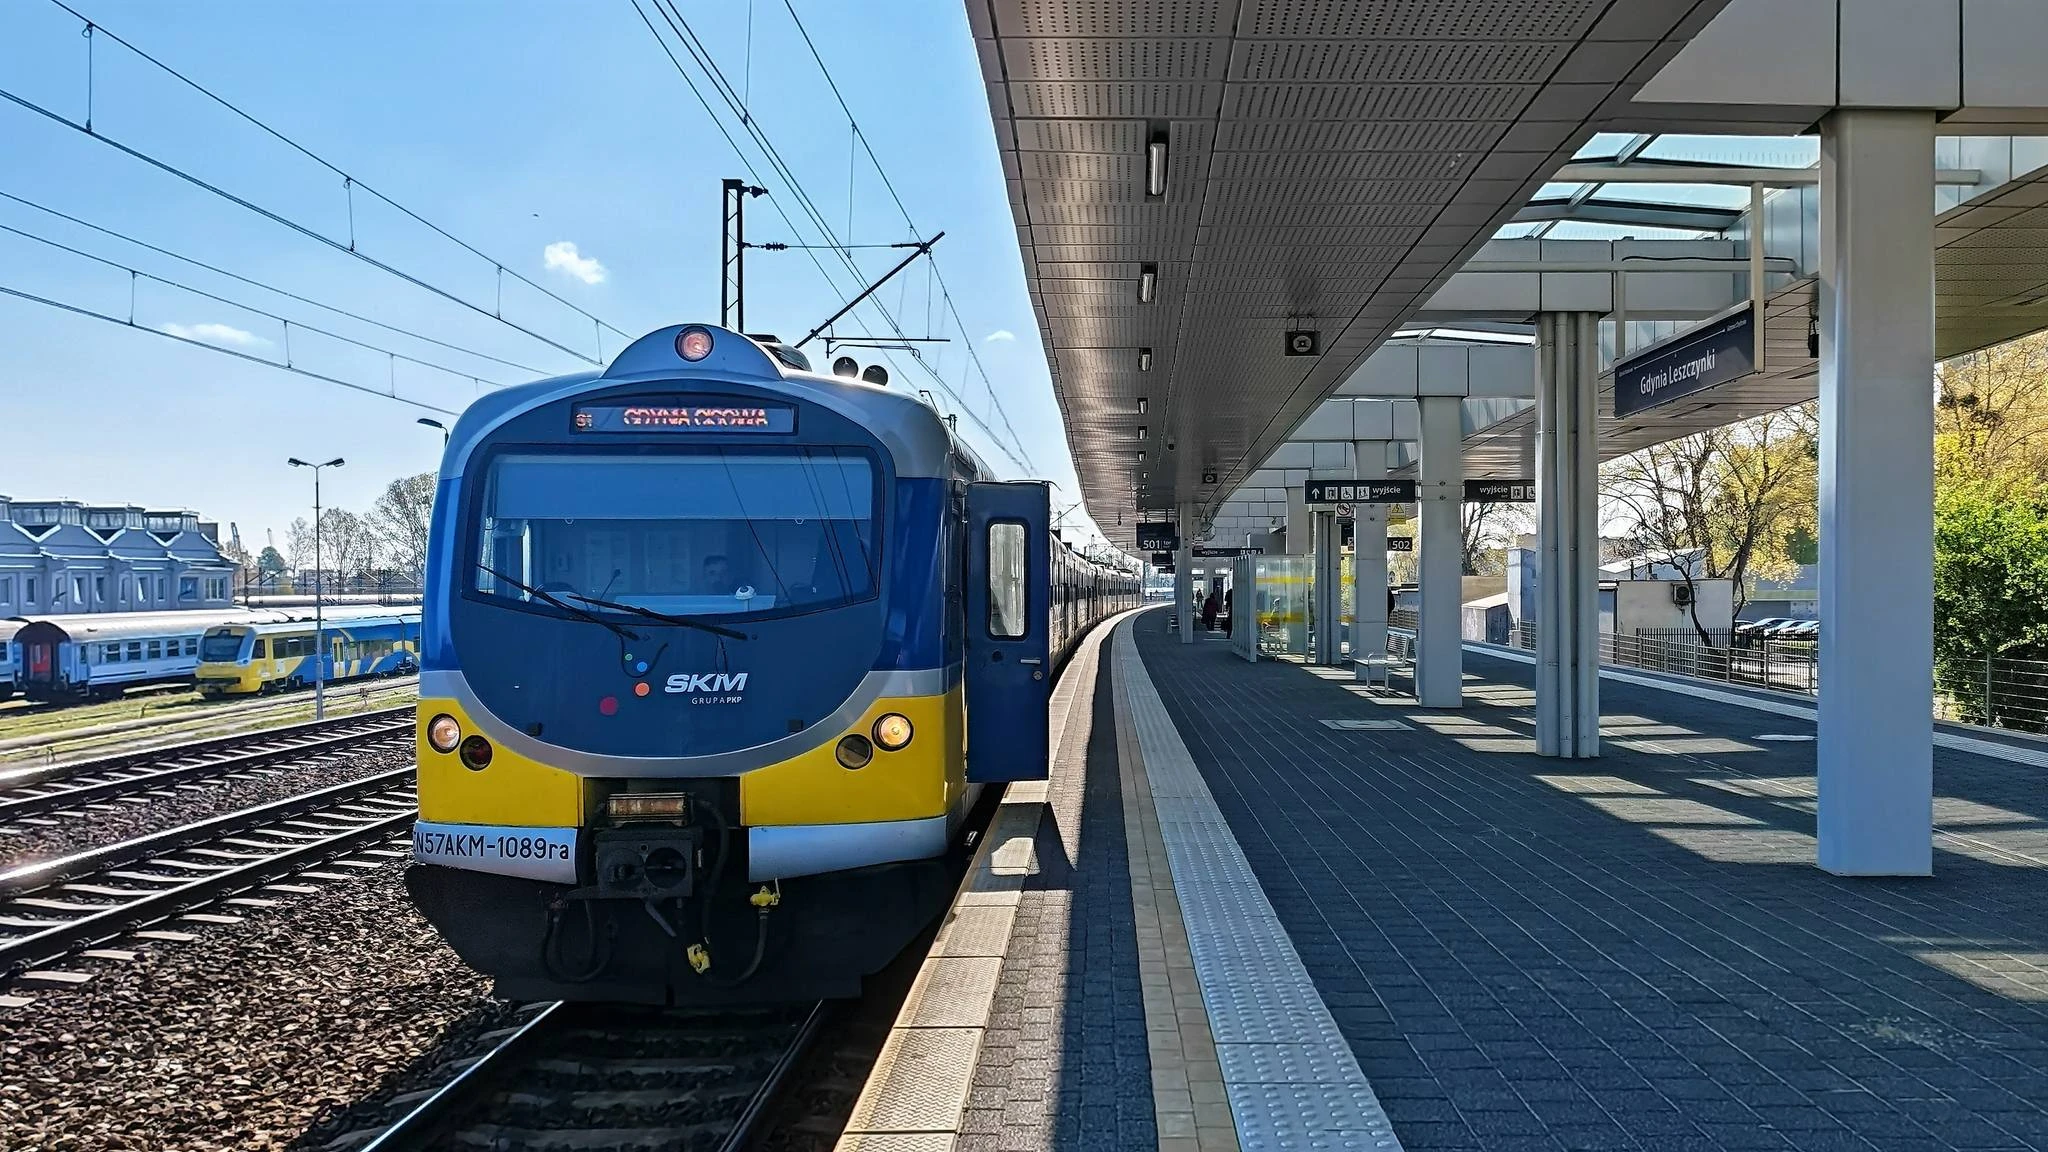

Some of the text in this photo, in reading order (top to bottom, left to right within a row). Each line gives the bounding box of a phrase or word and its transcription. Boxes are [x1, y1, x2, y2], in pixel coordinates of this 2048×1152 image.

[1640, 348, 1716, 397] Gdynia Leszczynki
[1372, 486, 1401, 496] wyjście
[1480, 485, 1508, 495] wyjście
[1143, 539, 1160, 549] 501
[1392, 540, 1410, 550] 502
[664, 672, 748, 693] SKM
[691, 696, 742, 704] GRUPA PKP
